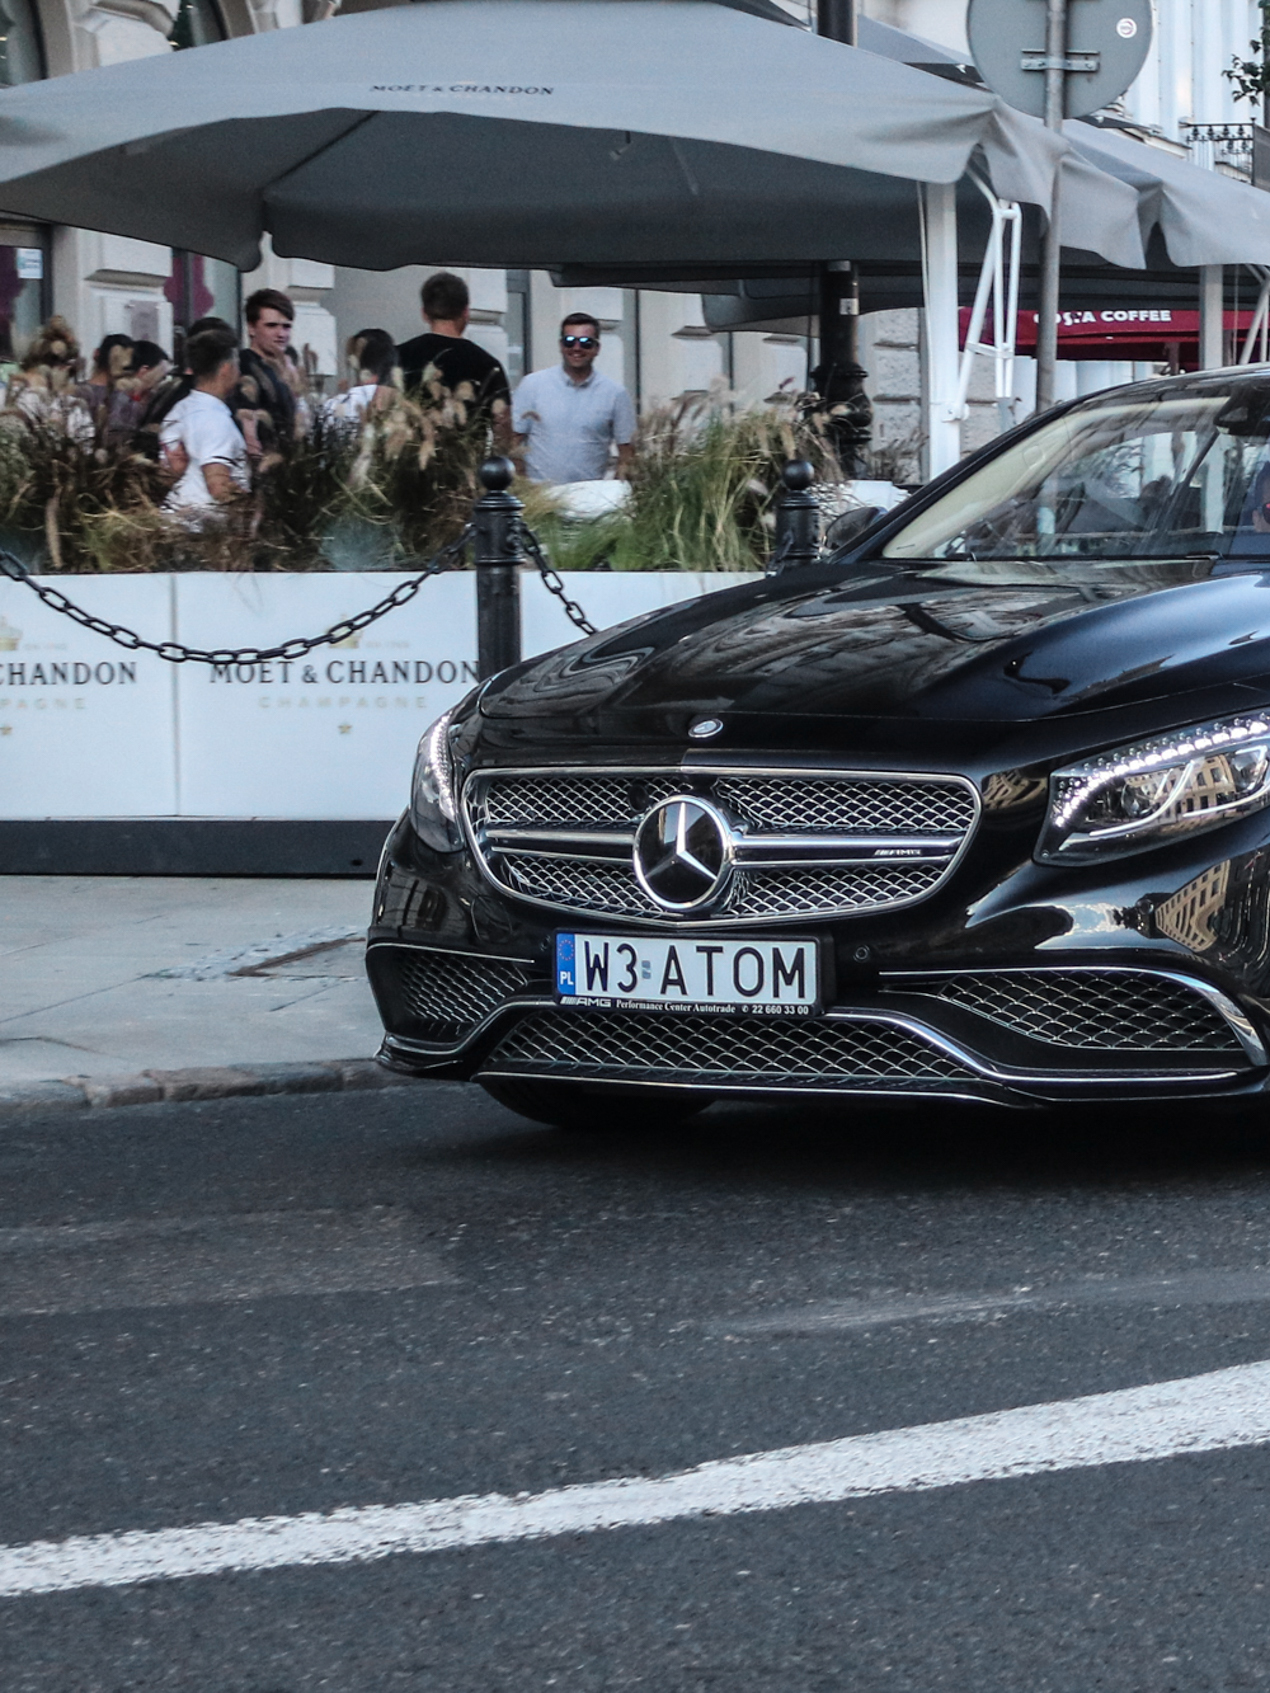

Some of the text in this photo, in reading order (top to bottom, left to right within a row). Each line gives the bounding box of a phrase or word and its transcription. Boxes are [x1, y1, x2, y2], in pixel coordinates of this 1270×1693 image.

[449, 85, 554, 95] CHANDON
[1100, 310, 1172, 322] COFFEE
[302, 664, 318, 684] &
[326, 660, 479, 684] CHANDON
[258, 697, 427, 709] CHAMPAGNE
[584, 941, 806, 999] W3 ATOM
[560, 971, 574, 985] PL
[616, 1000, 663, 1011] Performance
[664, 1003, 692, 1012] Center
[693, 1004, 736, 1013] Autotrade
[752, 1006, 763, 1014] 22
[765, 1005, 782, 1015] 660
[784, 1006, 796, 1015] 33
[797, 1006, 809, 1015] 00
